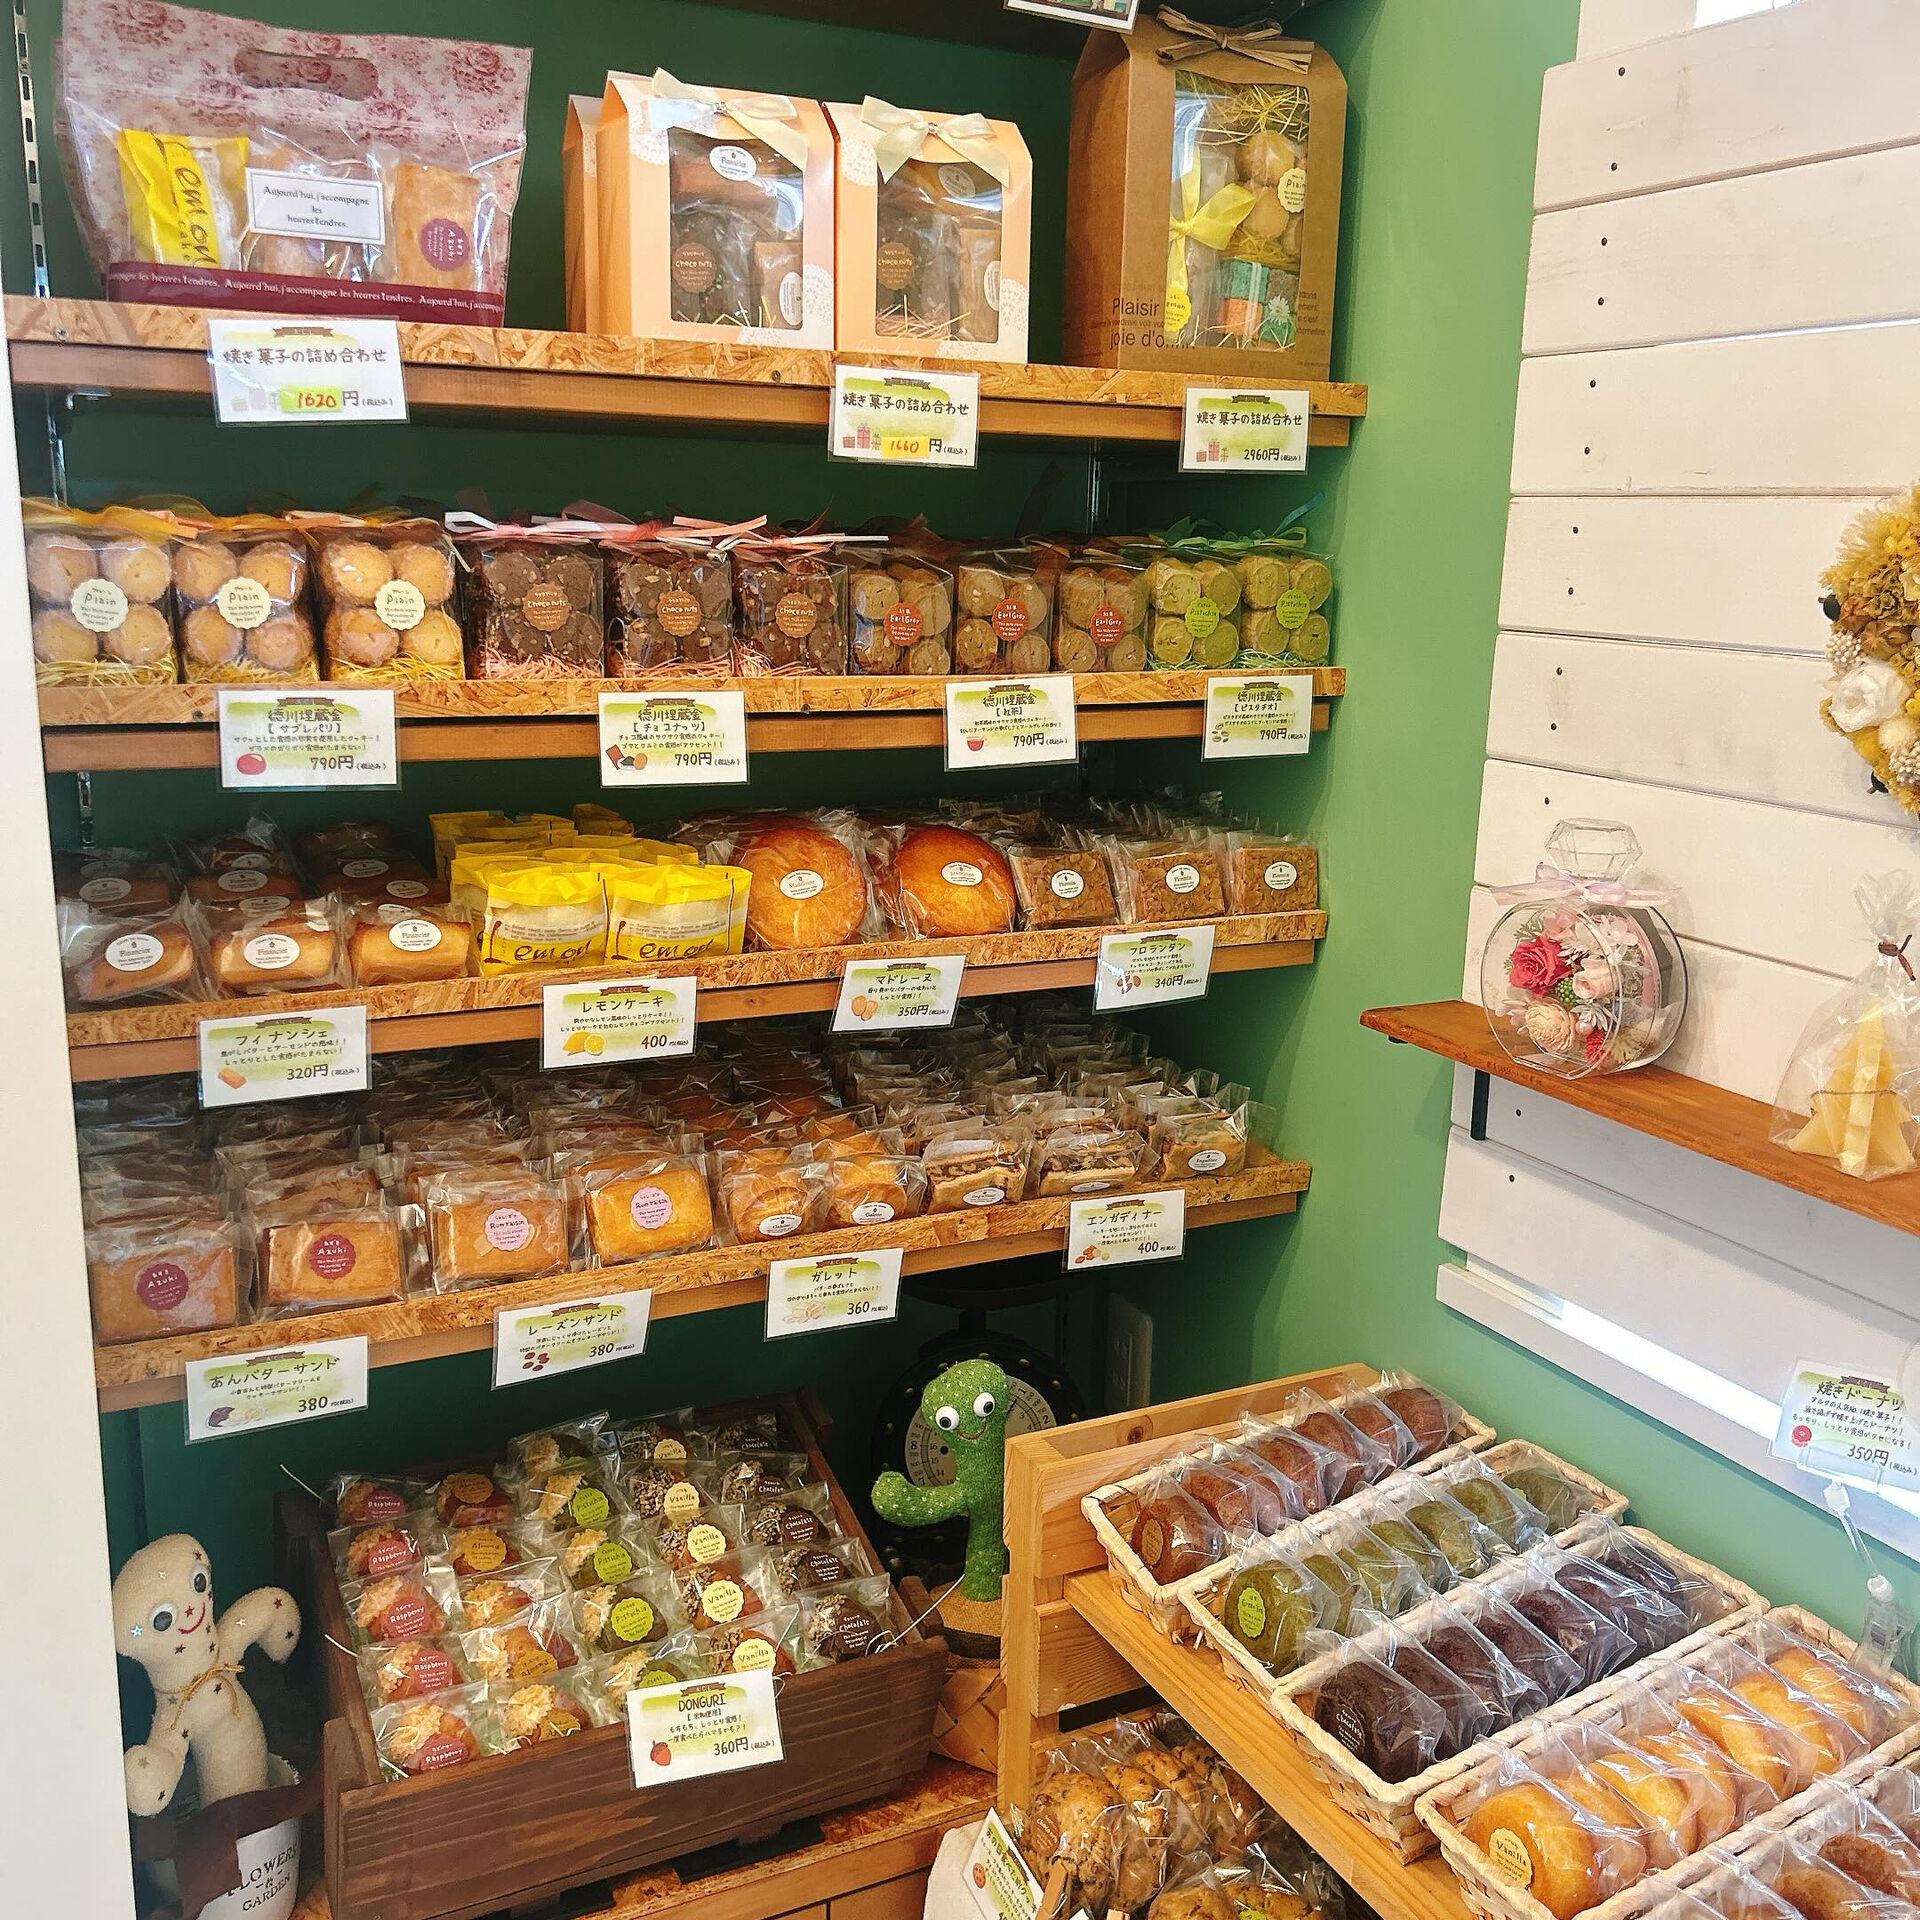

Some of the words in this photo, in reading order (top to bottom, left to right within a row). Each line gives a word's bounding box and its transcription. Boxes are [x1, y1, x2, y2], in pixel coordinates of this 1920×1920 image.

[842, 393, 969, 416] 焼き菓子の詰め合わせ
[1196, 411, 1303, 426] 焼き菓子の詰め合わせ
[83, 593, 117, 606] Plain
[228, 592, 260, 603] Plain
[386, 594, 415, 605] Plain
[983, 693, 1037, 707] 徳川埋蔵金
[637, 708, 704, 722] 徳川埋蔵金
[1130, 943, 1186, 956] フロランタン
[582, 995, 664, 1013] レモンケーキ
[236, 1027, 328, 1047] フィナンシェ
[641, 1034, 668, 1050] 400
[1087, 1210, 1162, 1226] エンガディナー
[317, 1247, 347, 1255] Azuki
[1137, 1241, 1159, 1254] 400
[811, 1268, 857, 1283] ガレット
[847, 1301, 870, 1315] 360
[528, 1309, 622, 1336] レーズンサンド
[589, 1342, 615, 1358] 380
[209, 1357, 341, 1389] あんバターサンド
[1816, 1381, 1906, 1412] 焼きドーナツ
[298, 1396, 328, 1413] 380
[367, 1500, 401, 1509] Raspberry
[669, 1493, 695, 1503] Vanilla
[692, 1533, 719, 1547] Vanilla
[372, 1550, 407, 1565] Raspberry
[707, 1587, 737, 1605] Vanilla
[389, 1606, 425, 1623] Raspberry
[738, 1649, 769, 1664] Vanilla
[414, 1660, 448, 1672] Raspberry
[678, 1693, 727, 1712] DONGURI
[713, 1736, 749, 1756] 360円
[425, 1748, 463, 1764] Raspberry
[1495, 1839, 1528, 1867] Vanilla
[242, 1872, 291, 1912] GARDEN
